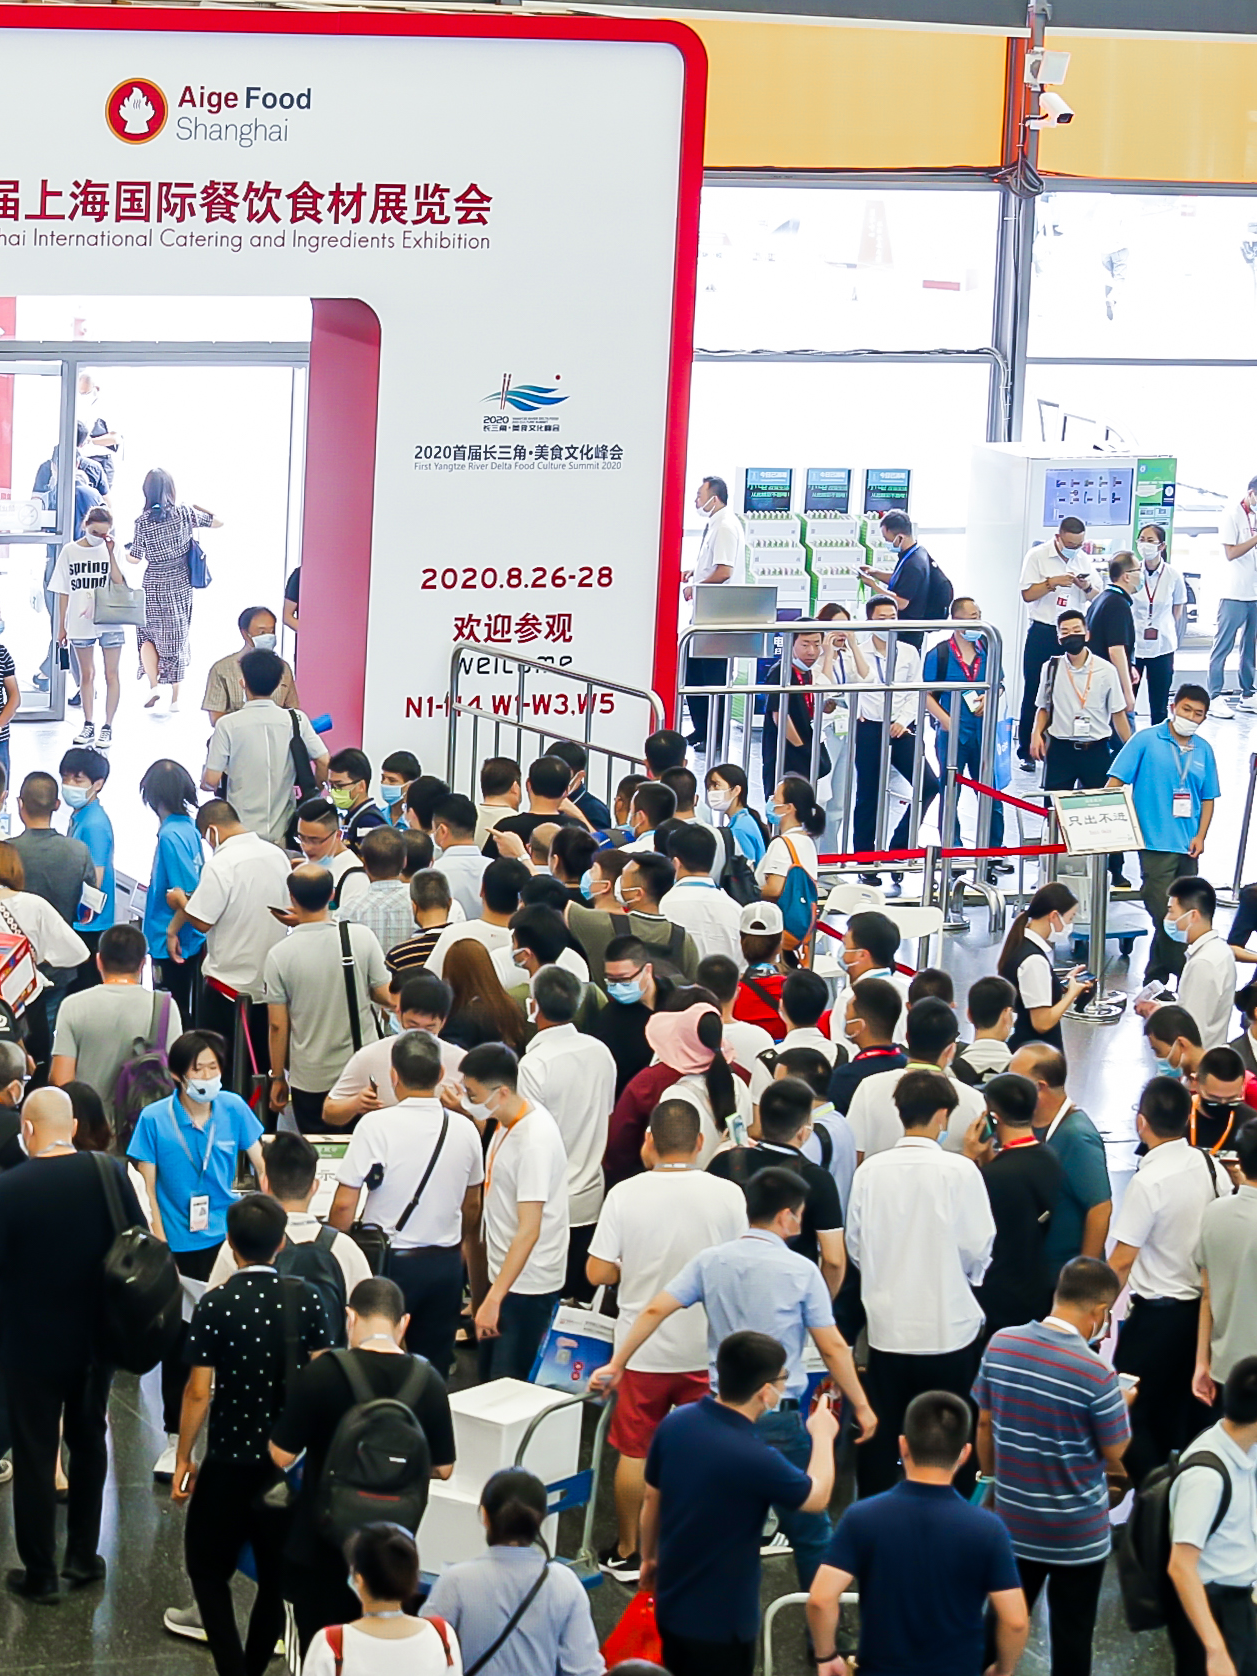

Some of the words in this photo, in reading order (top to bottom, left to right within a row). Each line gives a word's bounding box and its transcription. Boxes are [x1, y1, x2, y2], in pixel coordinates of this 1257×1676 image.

[177, 85, 239, 115] Aige
[245, 86, 312, 110] Food
[176, 116, 289, 149] Shanghai
[33, 227, 153, 248] International
[159, 227, 243, 253] Catering
[249, 229, 286, 248] and
[292, 229, 395, 254] Ingredients
[402, 230, 490, 250] Exhibition
[482, 416, 509, 424] 2020
[414, 444, 624, 461] 2020首届长三角·美食文化峰会
[414, 463, 432, 471] First
[433, 463, 466, 473] Yangtze
[468, 462, 489, 471] River
[490, 462, 513, 471] Delta
[514, 462, 535, 470] Food
[537, 462, 566, 470] Culture
[568, 461, 600, 470] Summit
[601, 462, 622, 470] 2020
[69, 561, 109, 576] spring
[71, 575, 107, 591] sound
[420, 566, 613, 590] 2020.8.26-28
[452, 612, 573, 643] 欢迎参观
[1069, 812, 1127, 826] 只出不进
